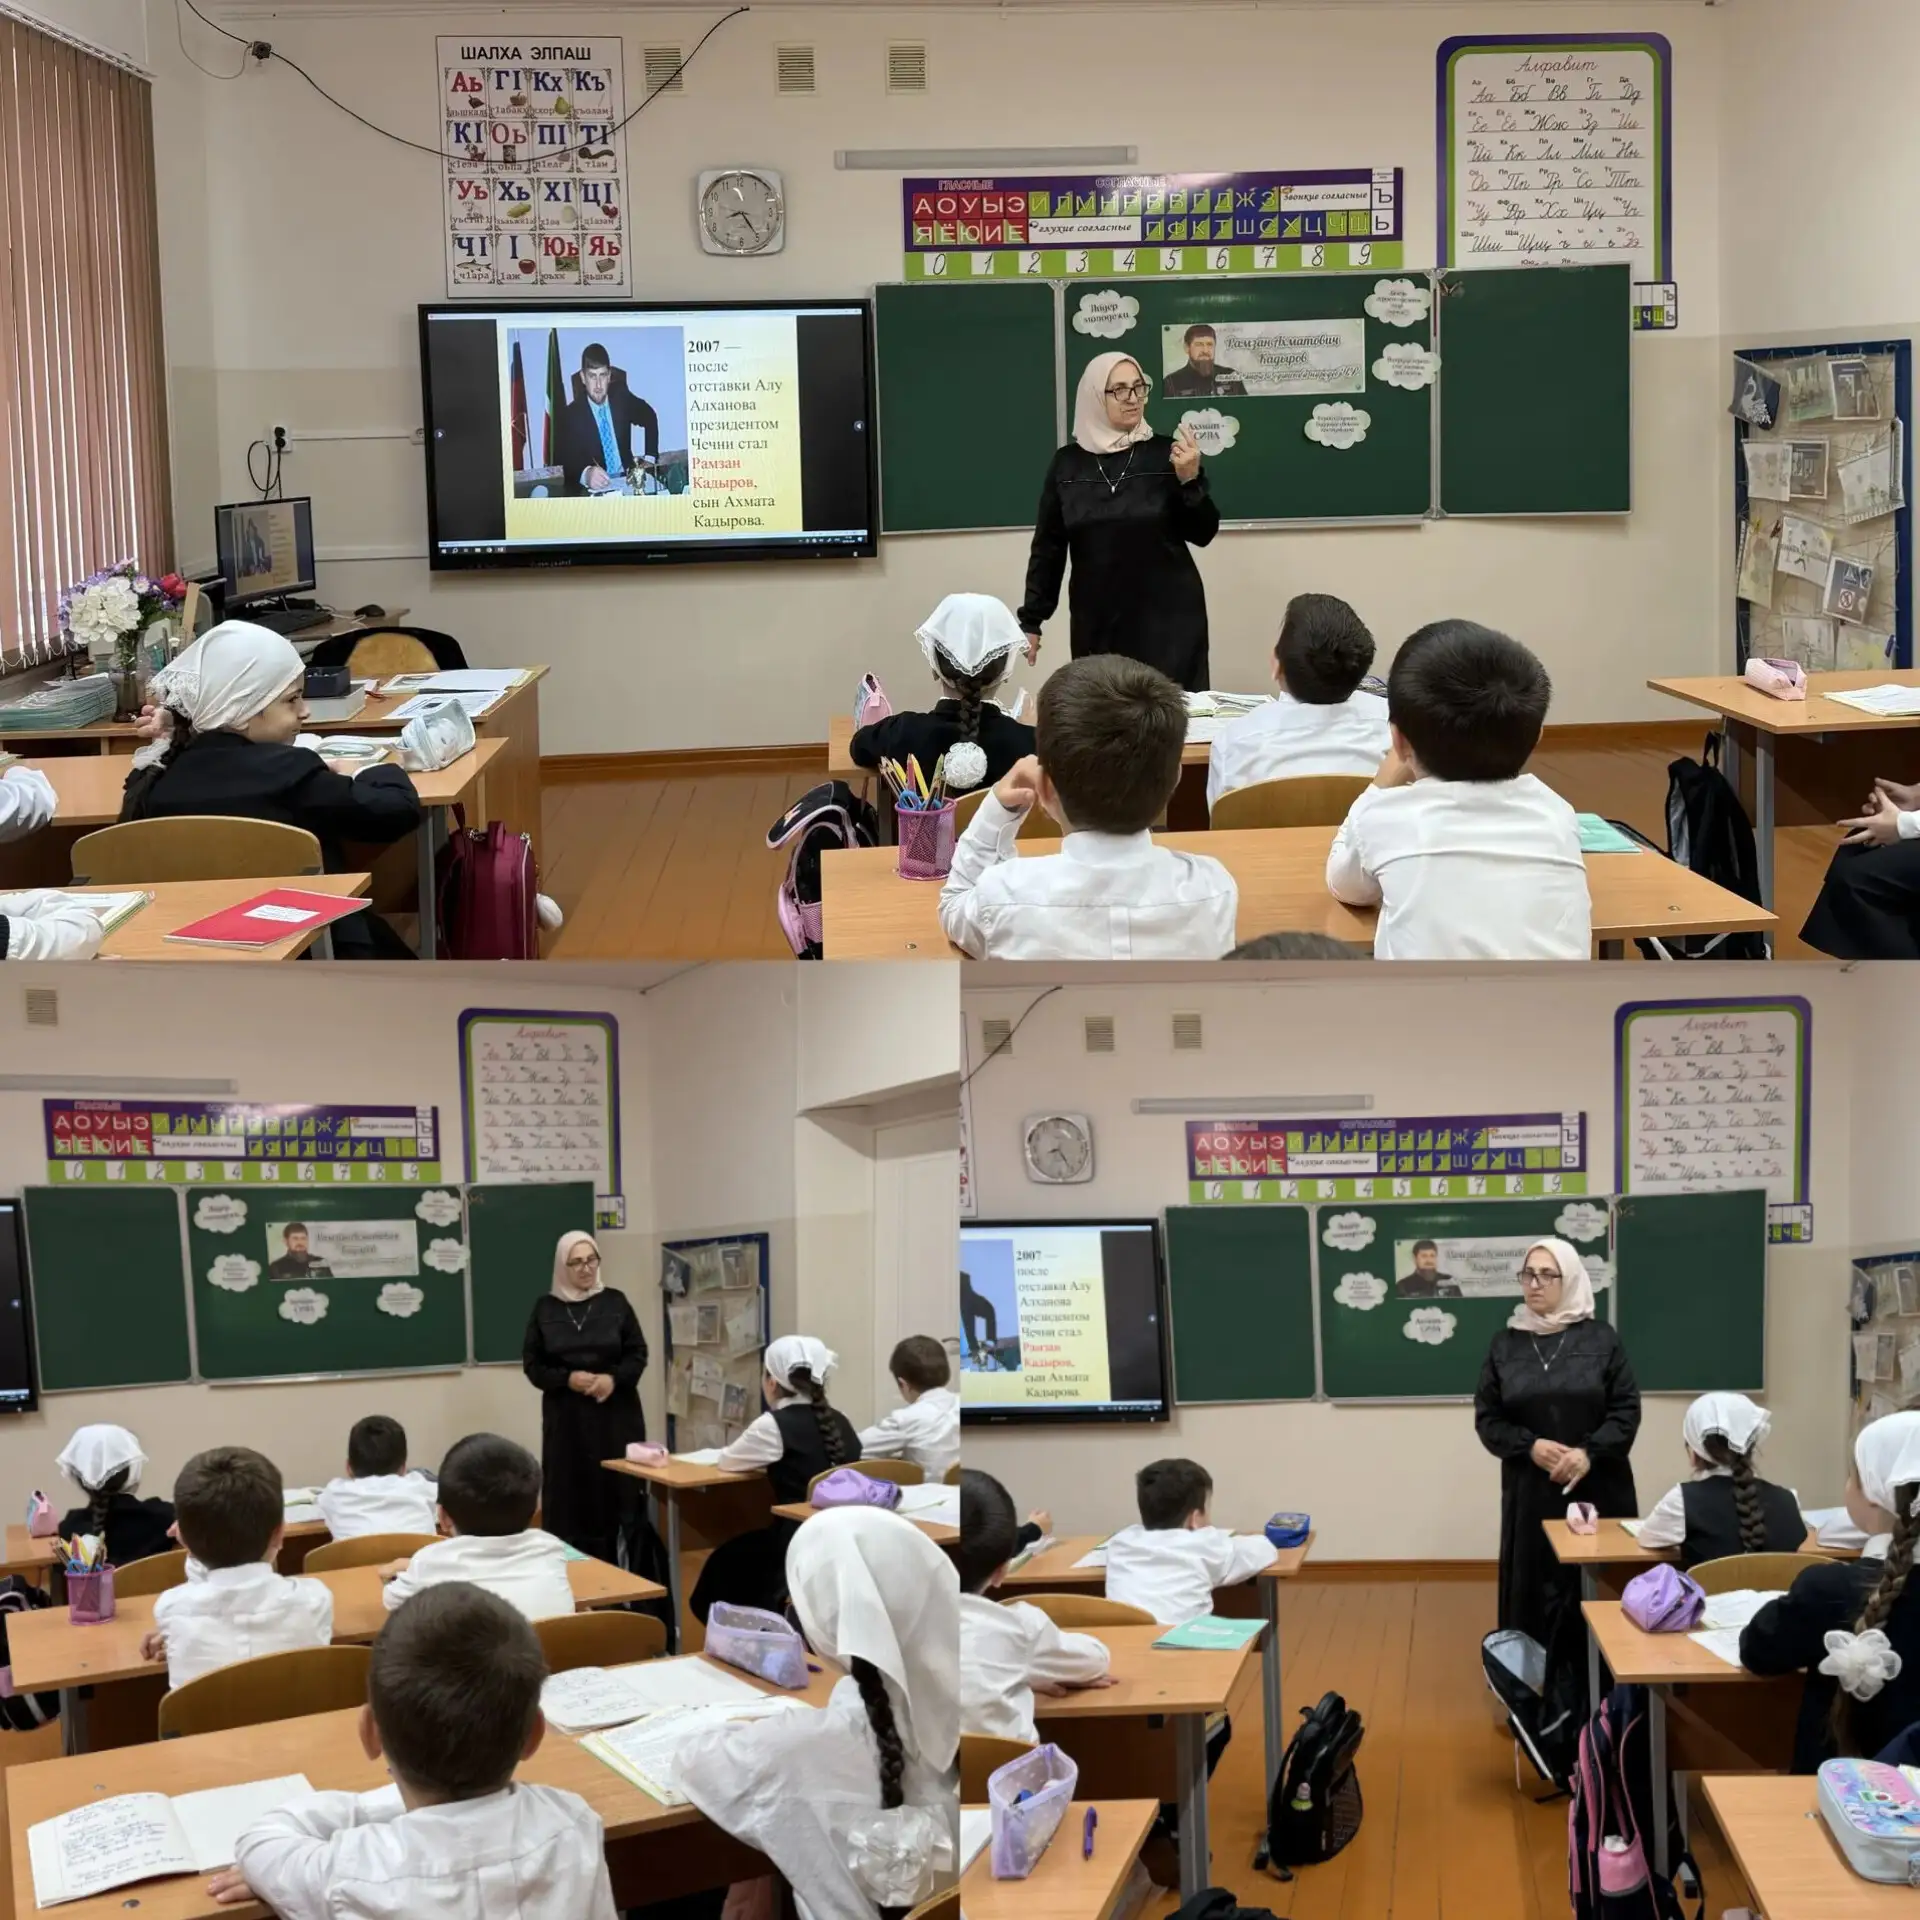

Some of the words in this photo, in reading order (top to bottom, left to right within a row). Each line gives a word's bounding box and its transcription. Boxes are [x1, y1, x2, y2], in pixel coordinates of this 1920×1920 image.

[461, 46, 522, 60] ШАЛХА
[531, 47, 591, 60] ЭЛПАШ
[1514, 55, 1598, 78] Алфавит
[450, 71, 483, 92] Аь
[533, 71, 563, 92] Кх
[576, 71, 605, 91] Къ
[492, 123, 527, 144] Оь
[456, 180, 488, 200] Уь
[498, 182, 531, 201] Хь
[938, 180, 994, 190] ГЛАСНЫЕ
[915, 198, 933, 214] А
[937, 198, 956, 214] О
[960, 198, 979, 214] У
[983, 197, 1004, 214] Ы
[1007, 196, 1026, 213] Э
[1076, 194, 1094, 210] М
[1214, 192, 1232, 209] Д
[1236, 191, 1256, 207] Ж
[1262, 191, 1275, 206] З
[1322, 190, 1368, 201] согласные
[1376, 188, 1393, 204] Ъ
[916, 226, 932, 243] Я
[940, 222, 956, 242] Ё
[960, 226, 980, 242] Ю
[984, 226, 1002, 242] И
[1008, 225, 1024, 241] Е
[1038, 224, 1074, 234] глухие
[1077, 223, 1132, 233] согласные
[1146, 221, 1160, 236] П
[1168, 219, 1185, 236] Ф
[1194, 220, 1207, 236] К
[1214, 220, 1230, 235] Т
[1236, 219, 1254, 235] Ш
[1260, 218, 1276, 234] С
[1284, 218, 1300, 234] Х
[1305, 217, 1322, 236] Ц
[1329, 216, 1344, 232] Ч
[1350, 216, 1368, 234] Щ
[542, 236, 580, 256] Юь
[588, 236, 620, 256] Яь
[932, 253, 946, 275] 0
[984, 252, 994, 274] 1
[1027, 252, 1042, 274] 2
[1075, 251, 1088, 272] 3
[1122, 250, 1135, 272] 4
[1165, 248, 1181, 270] 5
[1216, 247, 1228, 270] 6
[1262, 246, 1276, 268] 7
[1312, 244, 1324, 266] 8
[1358, 244, 1372, 266] 9
[688, 340, 720, 353] 2007
[1224, 336, 1272, 350] Рамзан
[1272, 334, 1341, 349] Ахматович
[688, 360, 728, 372] после
[1259, 352, 1308, 366] Кадыров
[688, 380, 750, 392] отставки
[754, 378, 783, 394] Алу
[690, 399, 756, 412] Алханова
[691, 420, 779, 434] президентом
[692, 438, 734, 450] Чечни
[738, 439, 768, 450] стал
[692, 456, 741, 470] Рамзан
[692, 476, 758, 492] Кадыров,
[692, 498, 720, 508] сын
[724, 496, 775, 508] Ахмата
[694, 514, 765, 530] Кадырова.
[1196, 1136, 1212, 1150] А
[1214, 1136, 1228, 1150] О
[1232, 1136, 1246, 1150] У
[1250, 1136, 1267, 1149] Ы
[1270, 1135, 1284, 1148] Э
[1016, 1250, 1042, 1261] 2007
[1017, 1266, 1049, 1276] после
[1018, 1282, 1066, 1292] отставки
[1070, 1281, 1091, 1293] Алу
[1020, 1297, 1071, 1307] Алханова
[1020, 1312, 1090, 1324] президентом
[1022, 1326, 1055, 1338] Чечни
[1058, 1327, 1082, 1338] стал
[1023, 1342, 1061, 1352] Рамзан
[1024, 1374, 1046, 1383] сын
[1048, 1372, 1090, 1383] Ахмата
